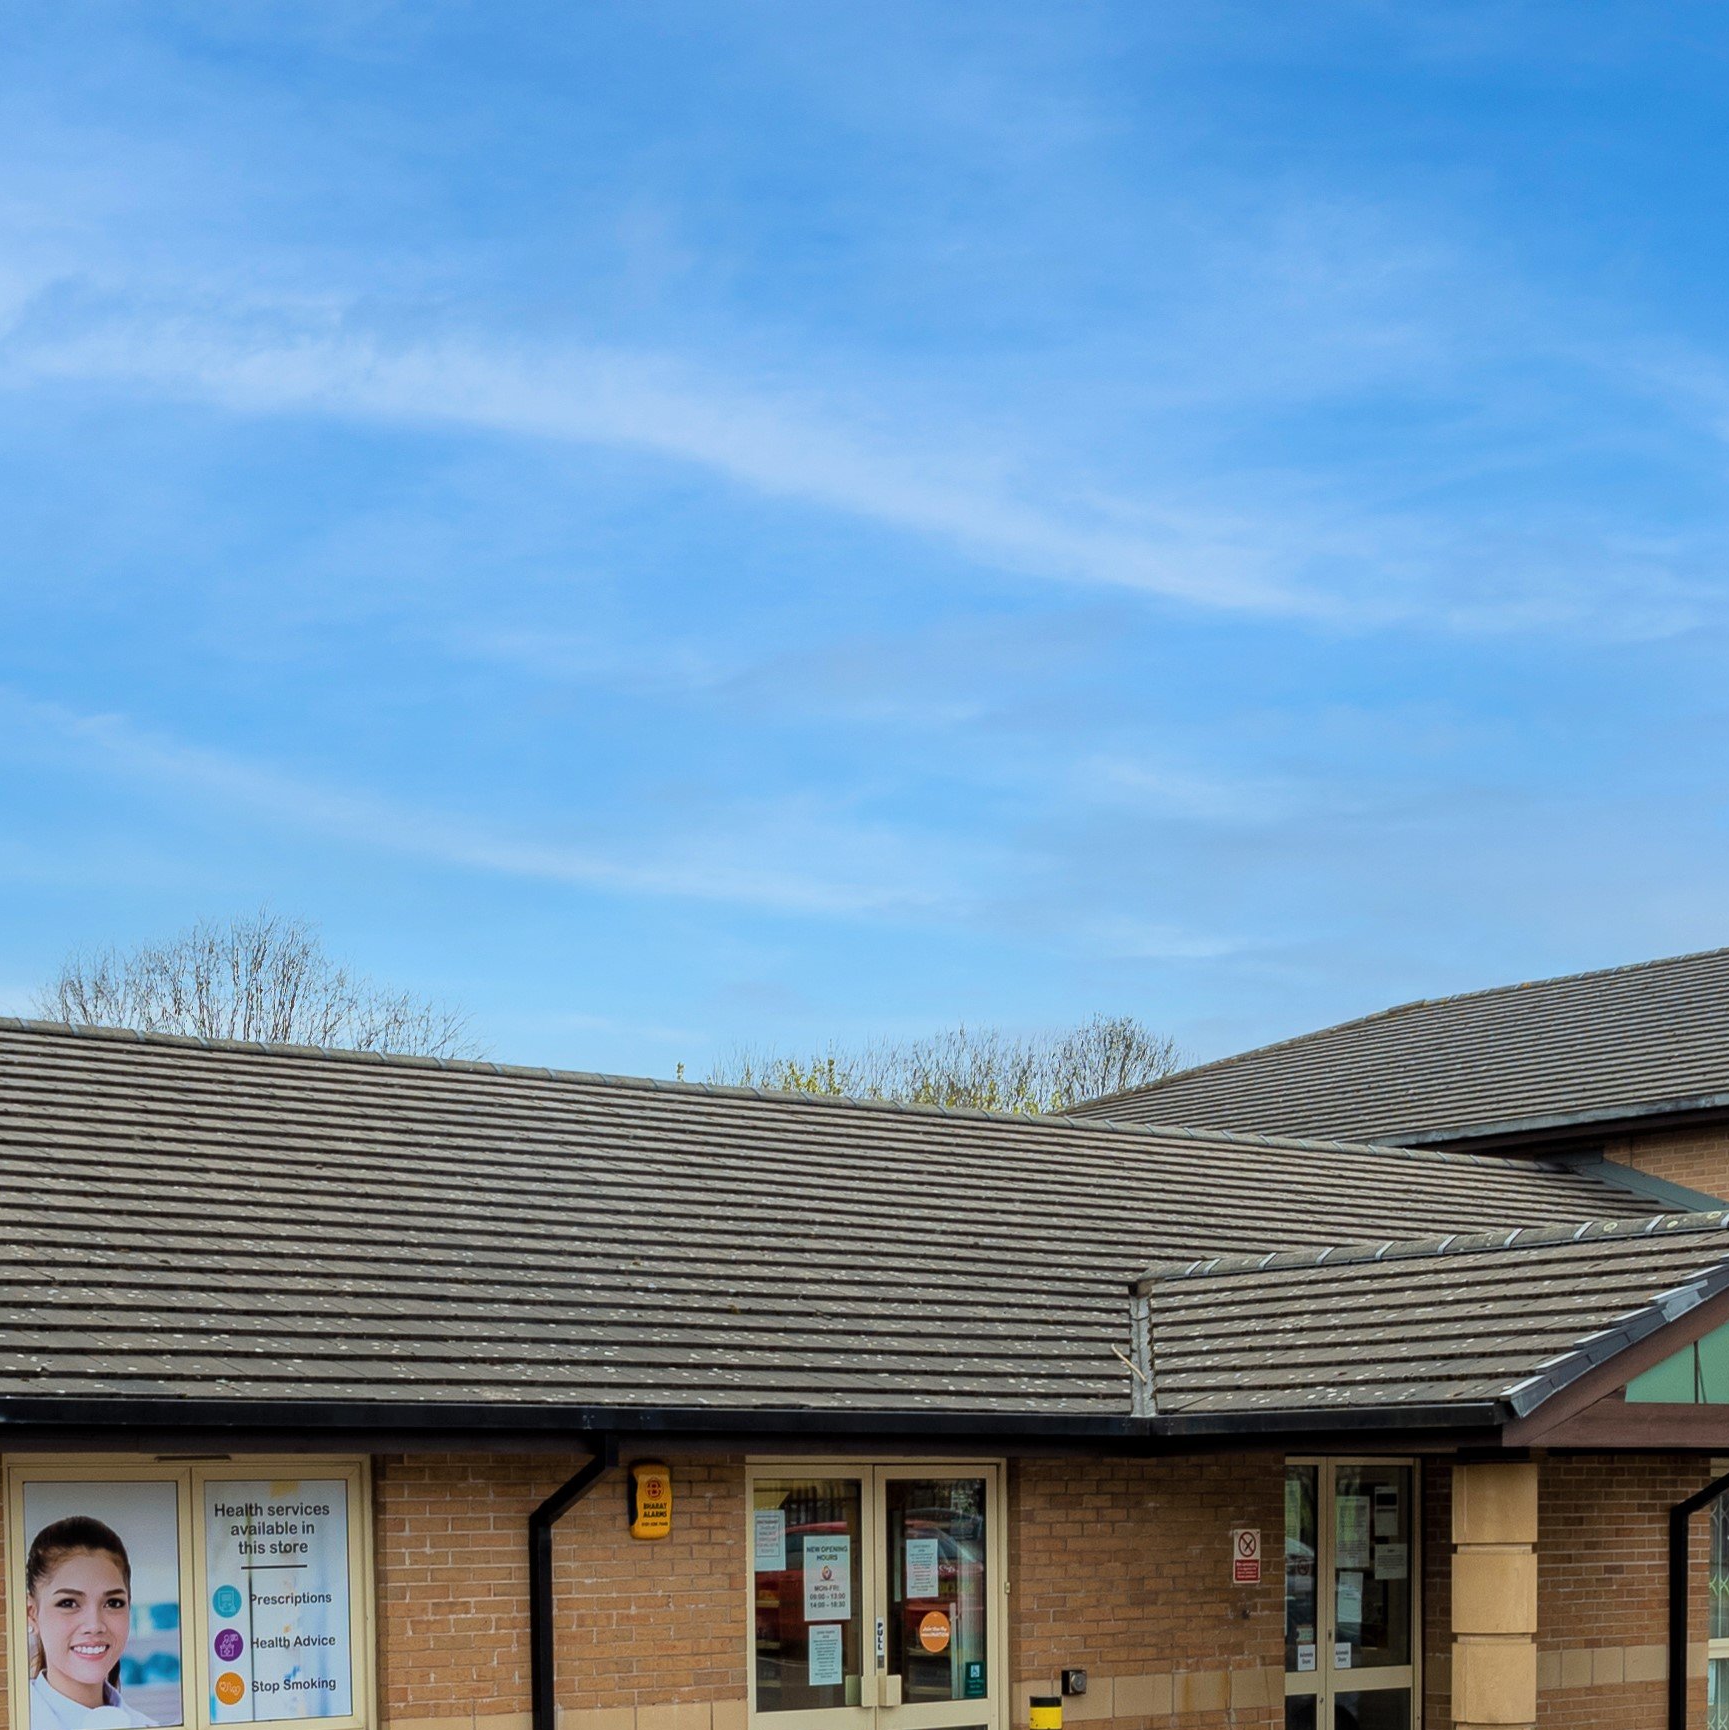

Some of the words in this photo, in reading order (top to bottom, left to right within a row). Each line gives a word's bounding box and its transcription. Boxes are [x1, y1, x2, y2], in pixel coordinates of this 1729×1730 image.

[214, 1503, 263, 1517] Health
[267, 1502, 330, 1516] services
[230, 1521, 298, 1536] available
[301, 1520, 315, 1534] in
[238, 1541, 266, 1555] this
[269, 1540, 308, 1554] store
[821, 1545, 848, 1553] OPENING
[250, 1592, 332, 1606] Prescriptions
[250, 1636, 291, 1649] Health
[293, 1634, 336, 1648] Advice
[251, 1680, 280, 1694] Stop
[283, 1677, 336, 1691] Smoking
